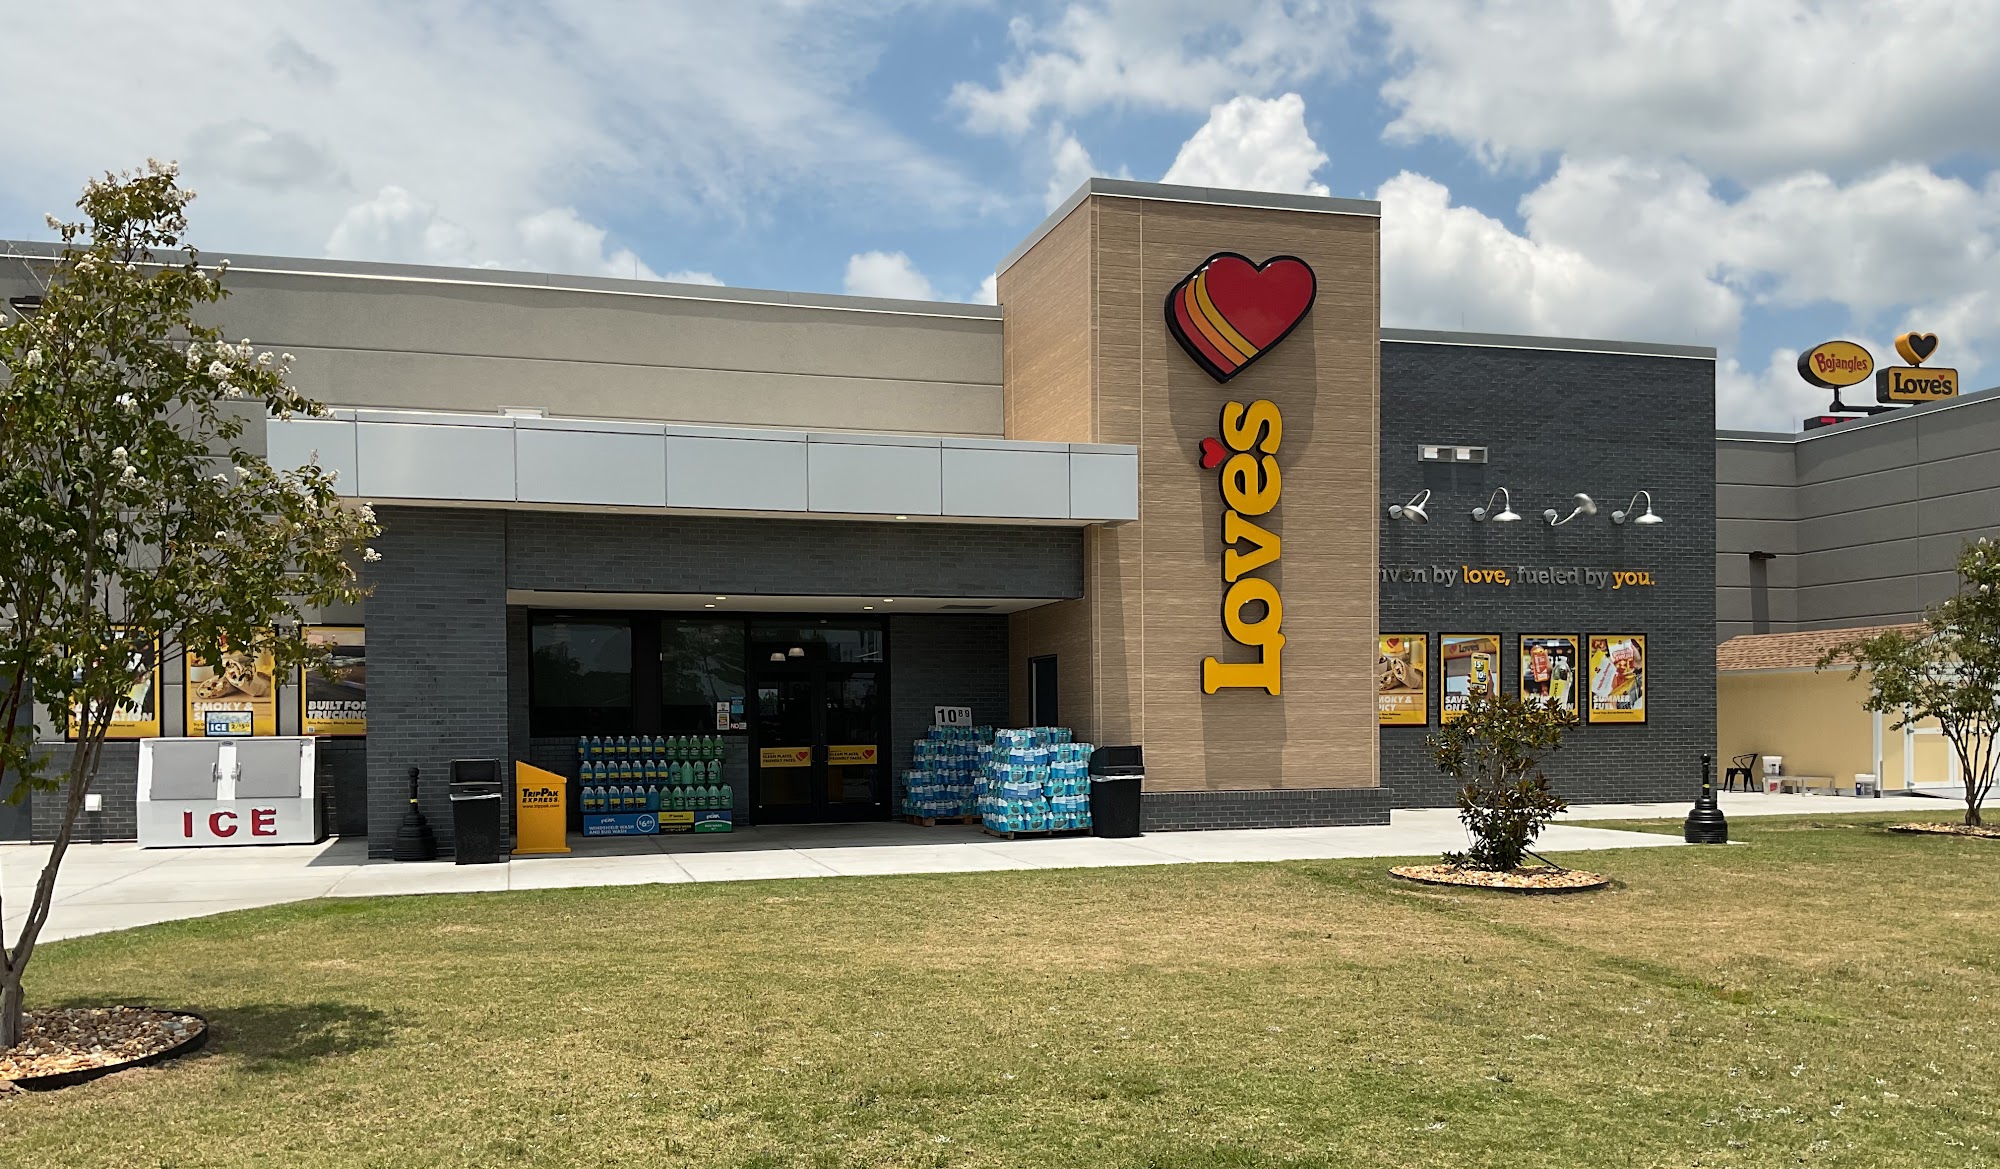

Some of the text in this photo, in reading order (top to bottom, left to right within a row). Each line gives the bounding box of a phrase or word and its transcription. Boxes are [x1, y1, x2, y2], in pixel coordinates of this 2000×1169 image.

[1815, 353, 1868, 373] Bojangles
[1380, 565, 1655, 590] iven by love, fueled by you.
[1445, 696, 1469, 704] SAVE
[1593, 695, 1630, 703] SUMMER
[193, 702, 253, 711] SMOKY &
[308, 701, 342, 710] BUILT
[210, 723, 227, 731] ICE
[183, 805, 277, 838] ICE
